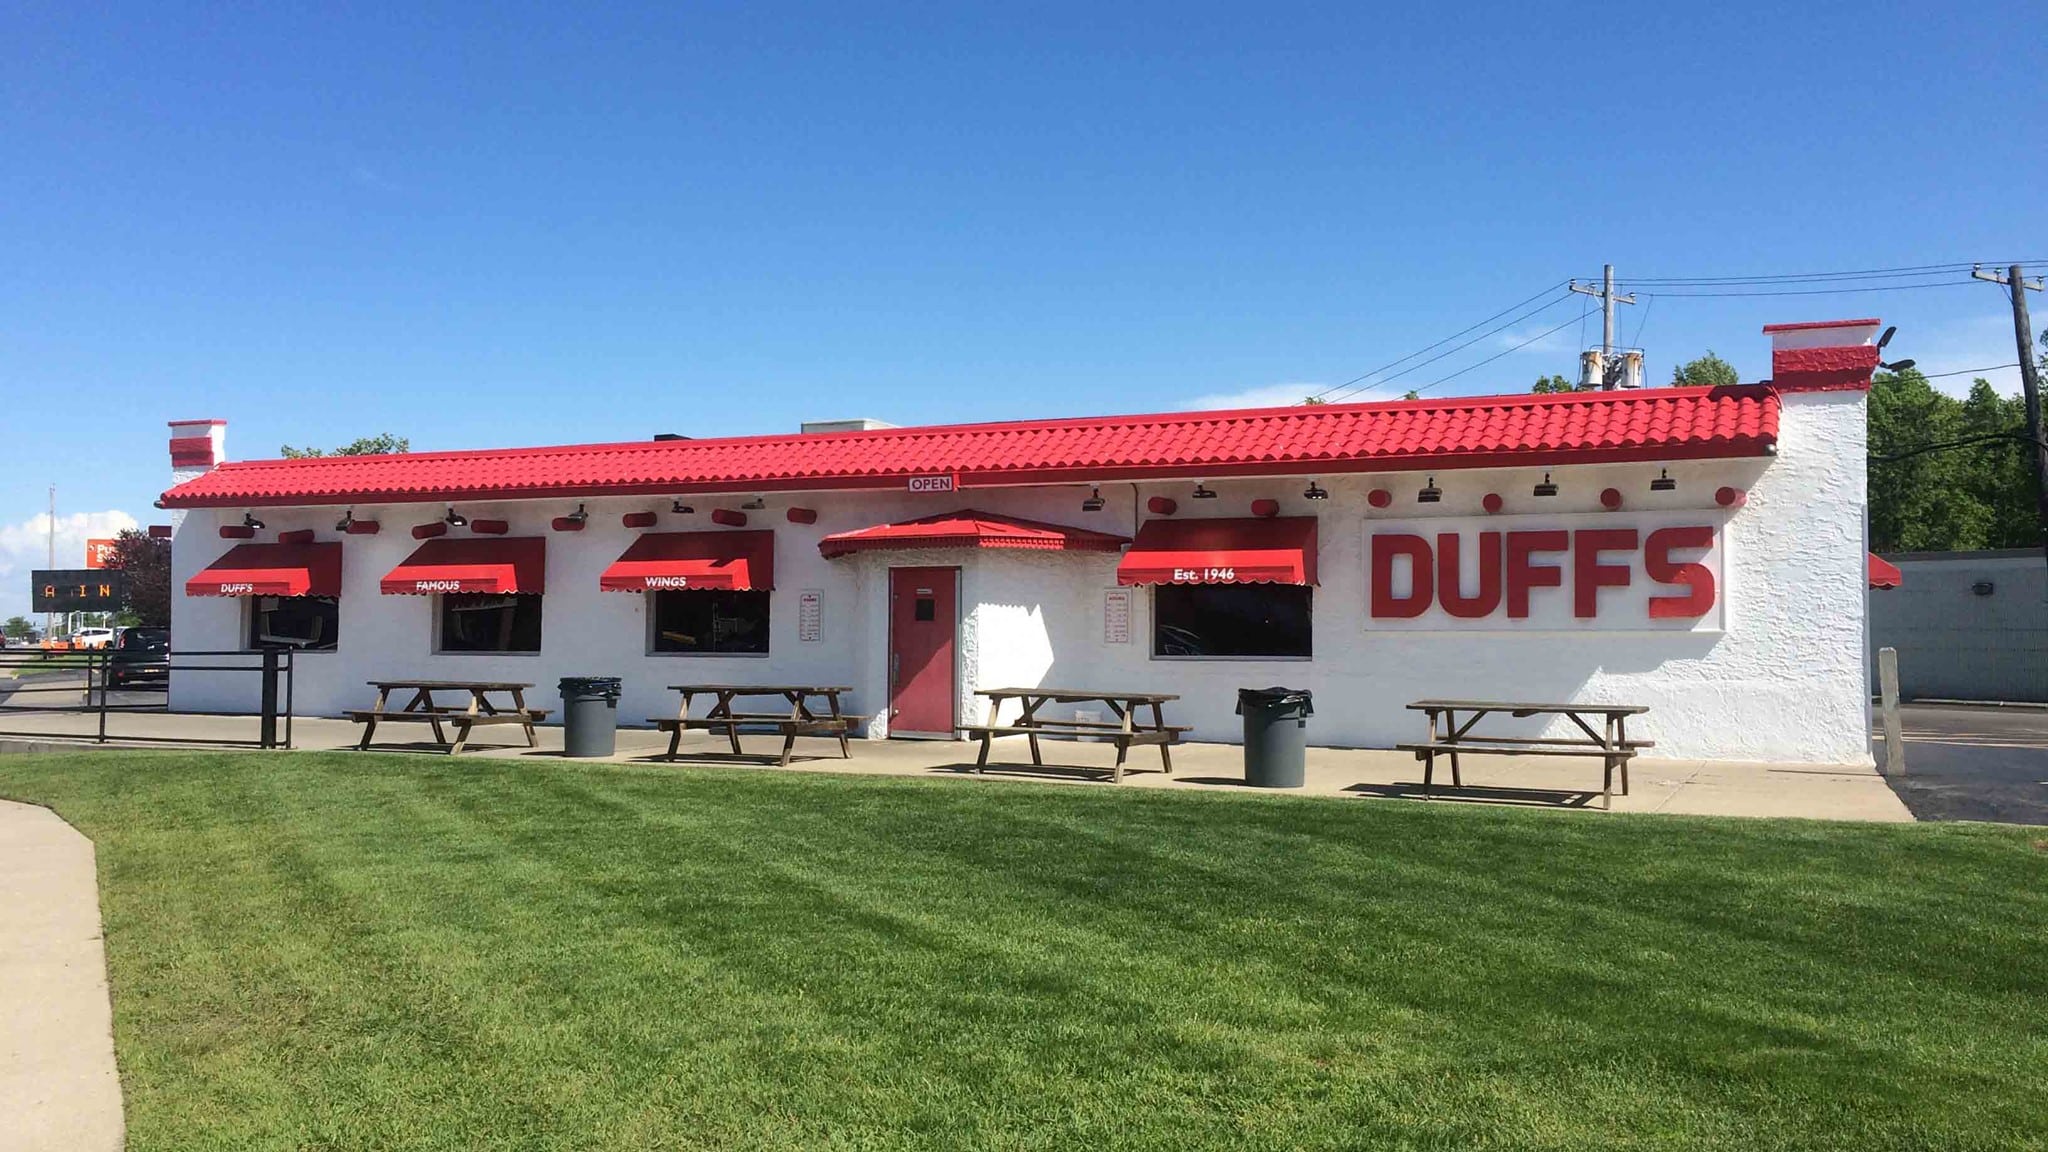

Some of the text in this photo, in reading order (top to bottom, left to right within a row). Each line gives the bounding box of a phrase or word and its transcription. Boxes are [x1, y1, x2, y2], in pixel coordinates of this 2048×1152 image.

[912, 479, 950, 490] OPEN
[1174, 568, 1235, 580] Est. 1946
[1371, 526, 1716, 618] DUFFS
[221, 583, 253, 593] DUFF'S
[416, 580, 461, 592] FAMOUS
[644, 576, 687, 589] WINGS
